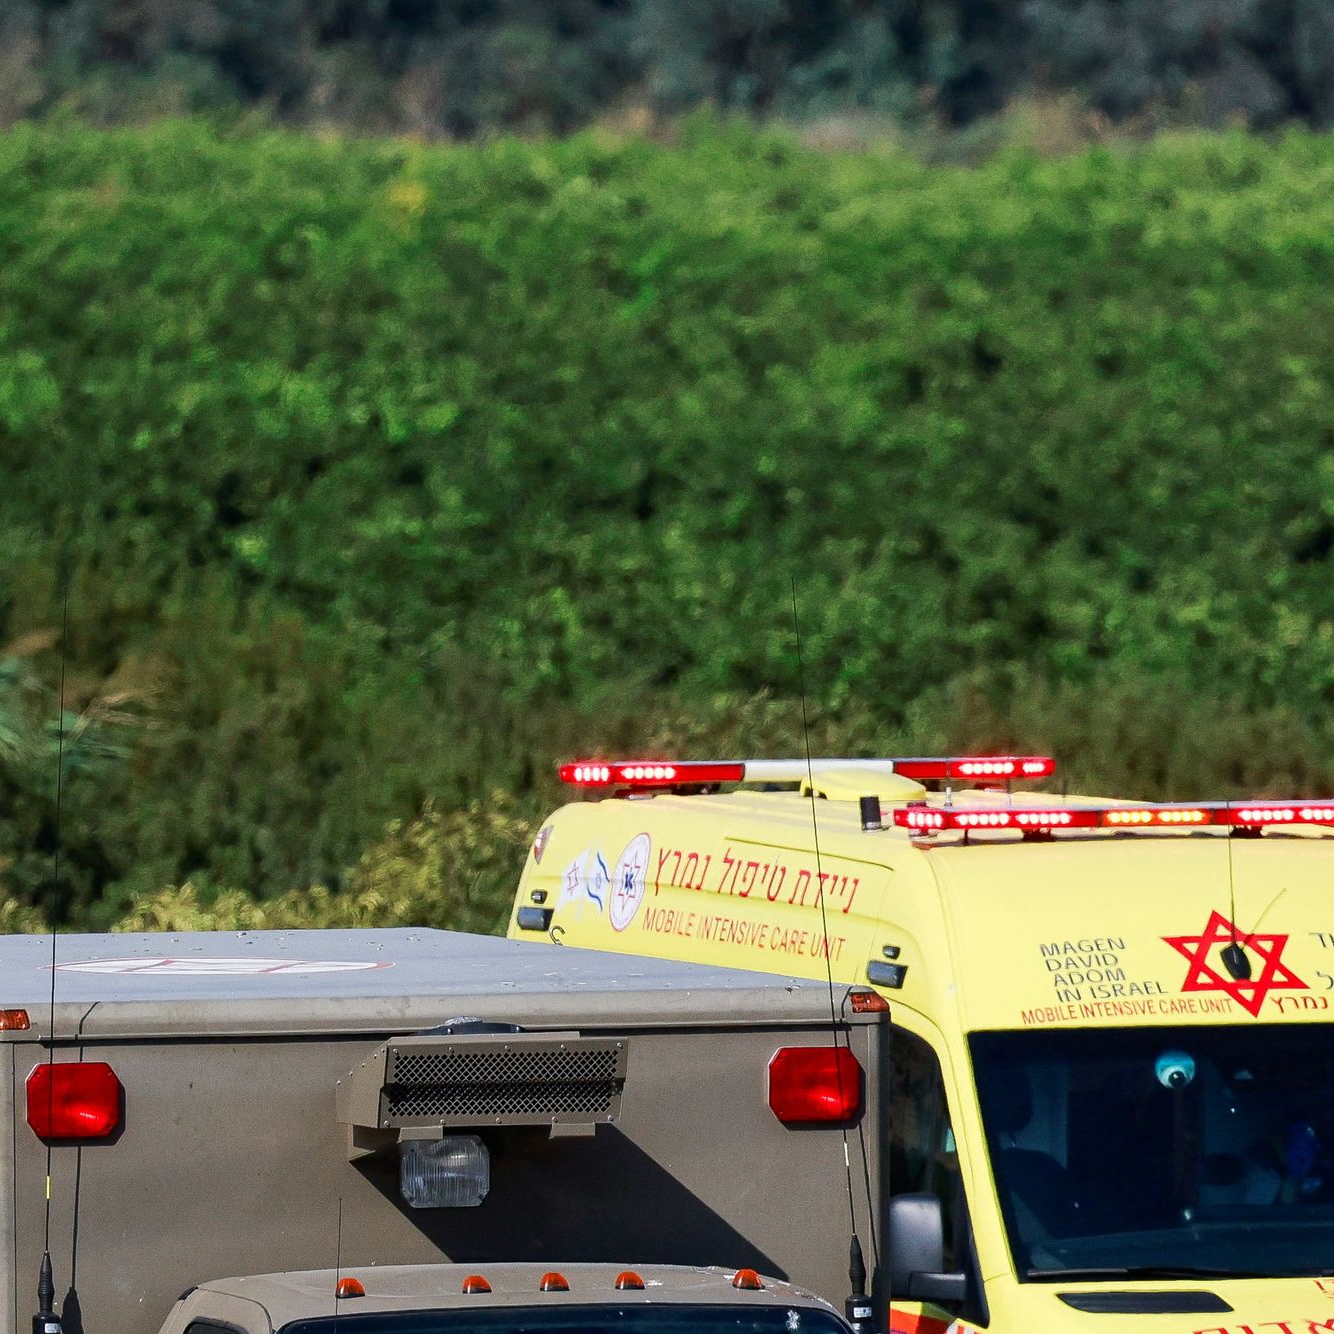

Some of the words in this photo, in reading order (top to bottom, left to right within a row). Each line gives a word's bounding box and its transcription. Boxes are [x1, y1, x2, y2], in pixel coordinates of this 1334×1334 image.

[655, 848, 711, 897] נמרץ
[718, 848, 786, 902] טיפול
[789, 870, 859, 914] ניידת
[642, 907, 696, 938] MOBILE
[698, 915, 768, 949] INTENSIVE
[770, 926, 809, 956] CARE
[810, 932, 846, 962] UNIT
[1039, 937, 1126, 957] MAGEN
[1045, 953, 1119, 972] DAVID
[1053, 968, 1126, 987] ADOM
[1056, 988, 1082, 1003] IN
[1089, 981, 1169, 999] ISRAEL
[1021, 1004, 1078, 1025] MOBILE
[1080, 999, 1156, 1019] INTENSIVE
[1159, 998, 1198, 1014] CARE
[1199, 998, 1234, 1014] UNIT
[1270, 995, 1329, 1014] נמרץ
